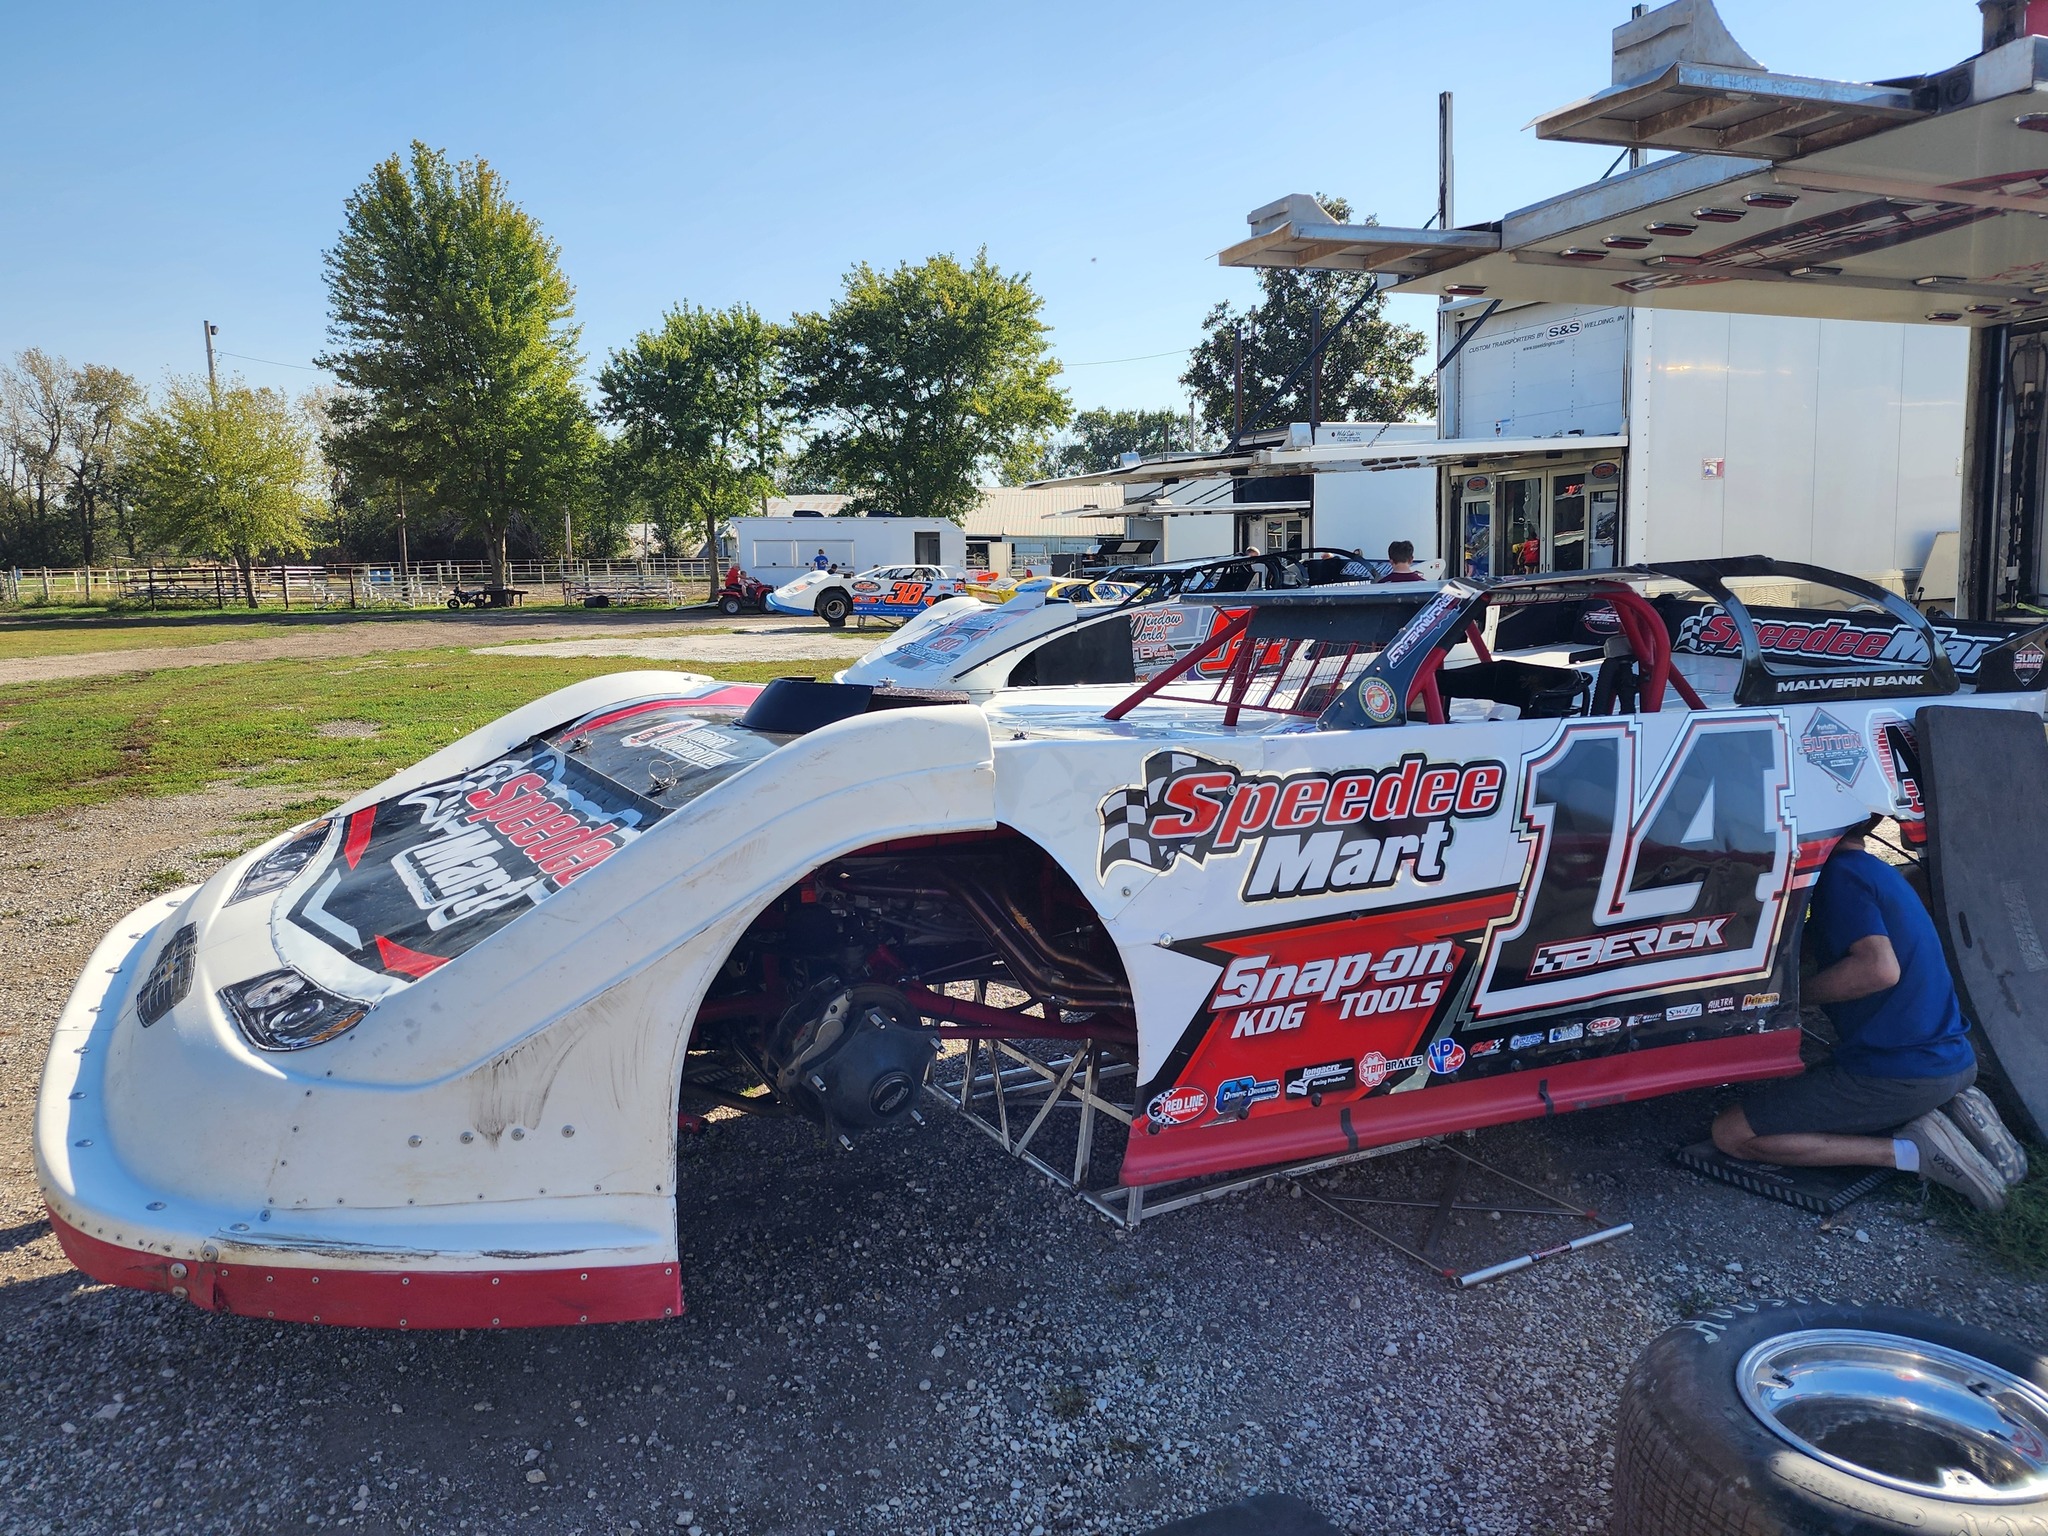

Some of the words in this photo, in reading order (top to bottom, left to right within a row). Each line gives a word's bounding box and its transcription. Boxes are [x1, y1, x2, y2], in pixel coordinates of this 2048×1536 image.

[1468, 343, 1491, 354] CUSTOM
[1492, 333, 1536, 349] TRANSPORTERS
[1537, 331, 1545, 341] BY
[1548, 322, 1580, 337] S&S
[1583, 316, 1615, 329] WELDING,
[884, 582, 929, 605] 38
[1879, 630, 1990, 667] Mar
[1777, 678, 1869, 693] MALVERN
[1873, 675, 1925, 687] BANK
[1801, 733, 1863, 753] SUTTON
[1149, 757, 1503, 848] Speedee
[414, 824, 538, 913] Mart
[1245, 822, 1450, 897] Mart
[1484, 716, 1785, 998] 14
[1563, 917, 1727, 972] BERCK
[1211, 940, 1453, 1011] Snap-on
[1231, 1001, 1308, 1039] KDG
[1339, 980, 1443, 1020] TOOLS
[1592, 1020, 1616, 1028] DRP
[1303, 1063, 1340, 1079] Longacre
[1385, 1056, 1423, 1071] BRAKES
[1428, 1038, 1454, 1072] VP
[1312, 1079, 1327, 1087] Racing
[1328, 1075, 1346, 1084] Products
[1165, 1098, 1184, 1112] RED
[1185, 1094, 1205, 1109] LINE
[1933, 1153, 1964, 1180] HOKA
